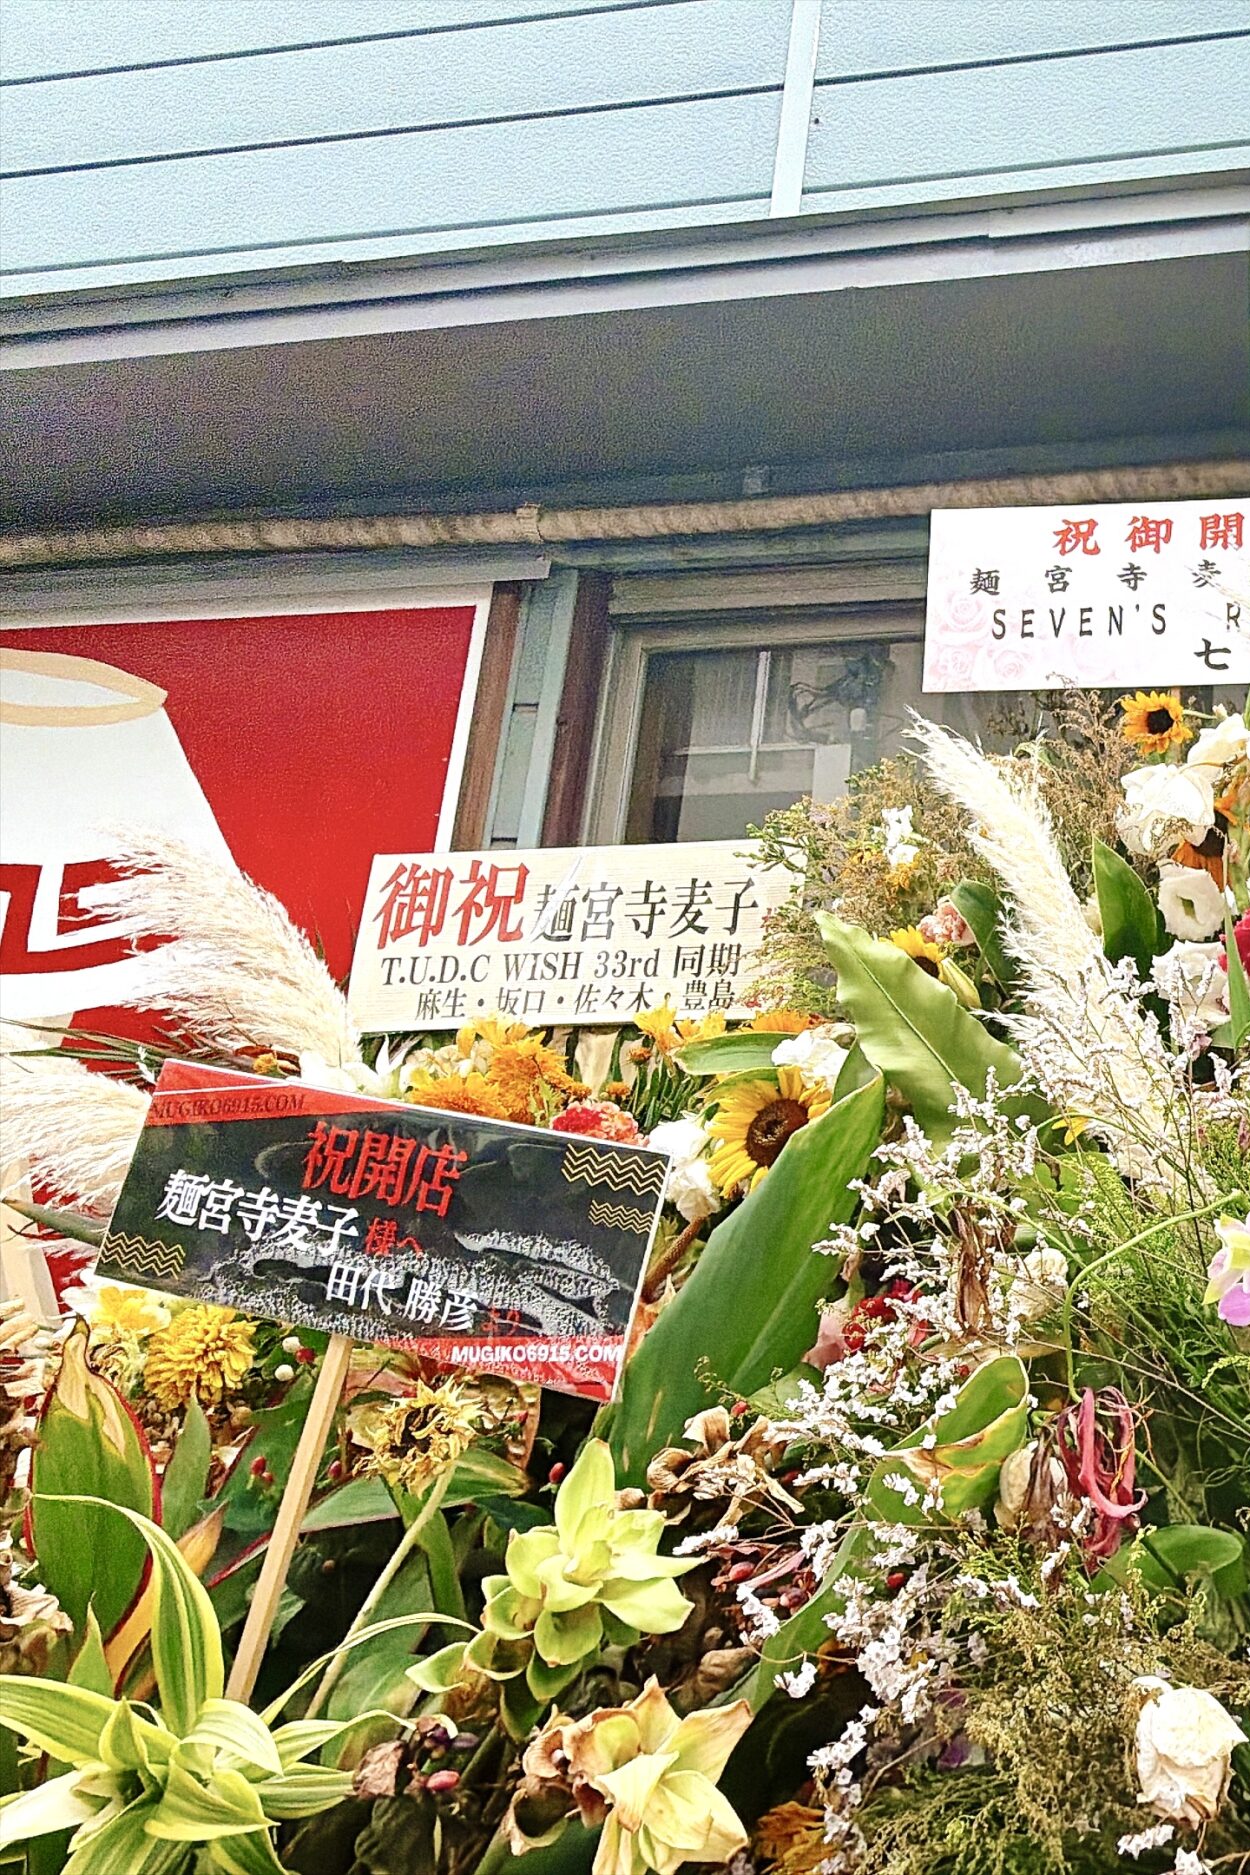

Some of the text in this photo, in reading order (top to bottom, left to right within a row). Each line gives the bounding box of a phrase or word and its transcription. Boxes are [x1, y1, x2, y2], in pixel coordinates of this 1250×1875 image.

[1052, 512, 1245, 556] 祝御開
[991, 603, 1167, 640] SEVEN'S
[1193, 638, 1232, 671] 七
[372, 860, 531, 950] 御祝
[380, 943, 742, 986] T.U.D.C WISH 33rd 同期
[302, 1120, 468, 1218] 祝開店
[326, 1264, 396, 1316] 田代
[403, 1279, 480, 1331] 勝彦
[451, 1344, 624, 1364] MUGIKO6915.COM
